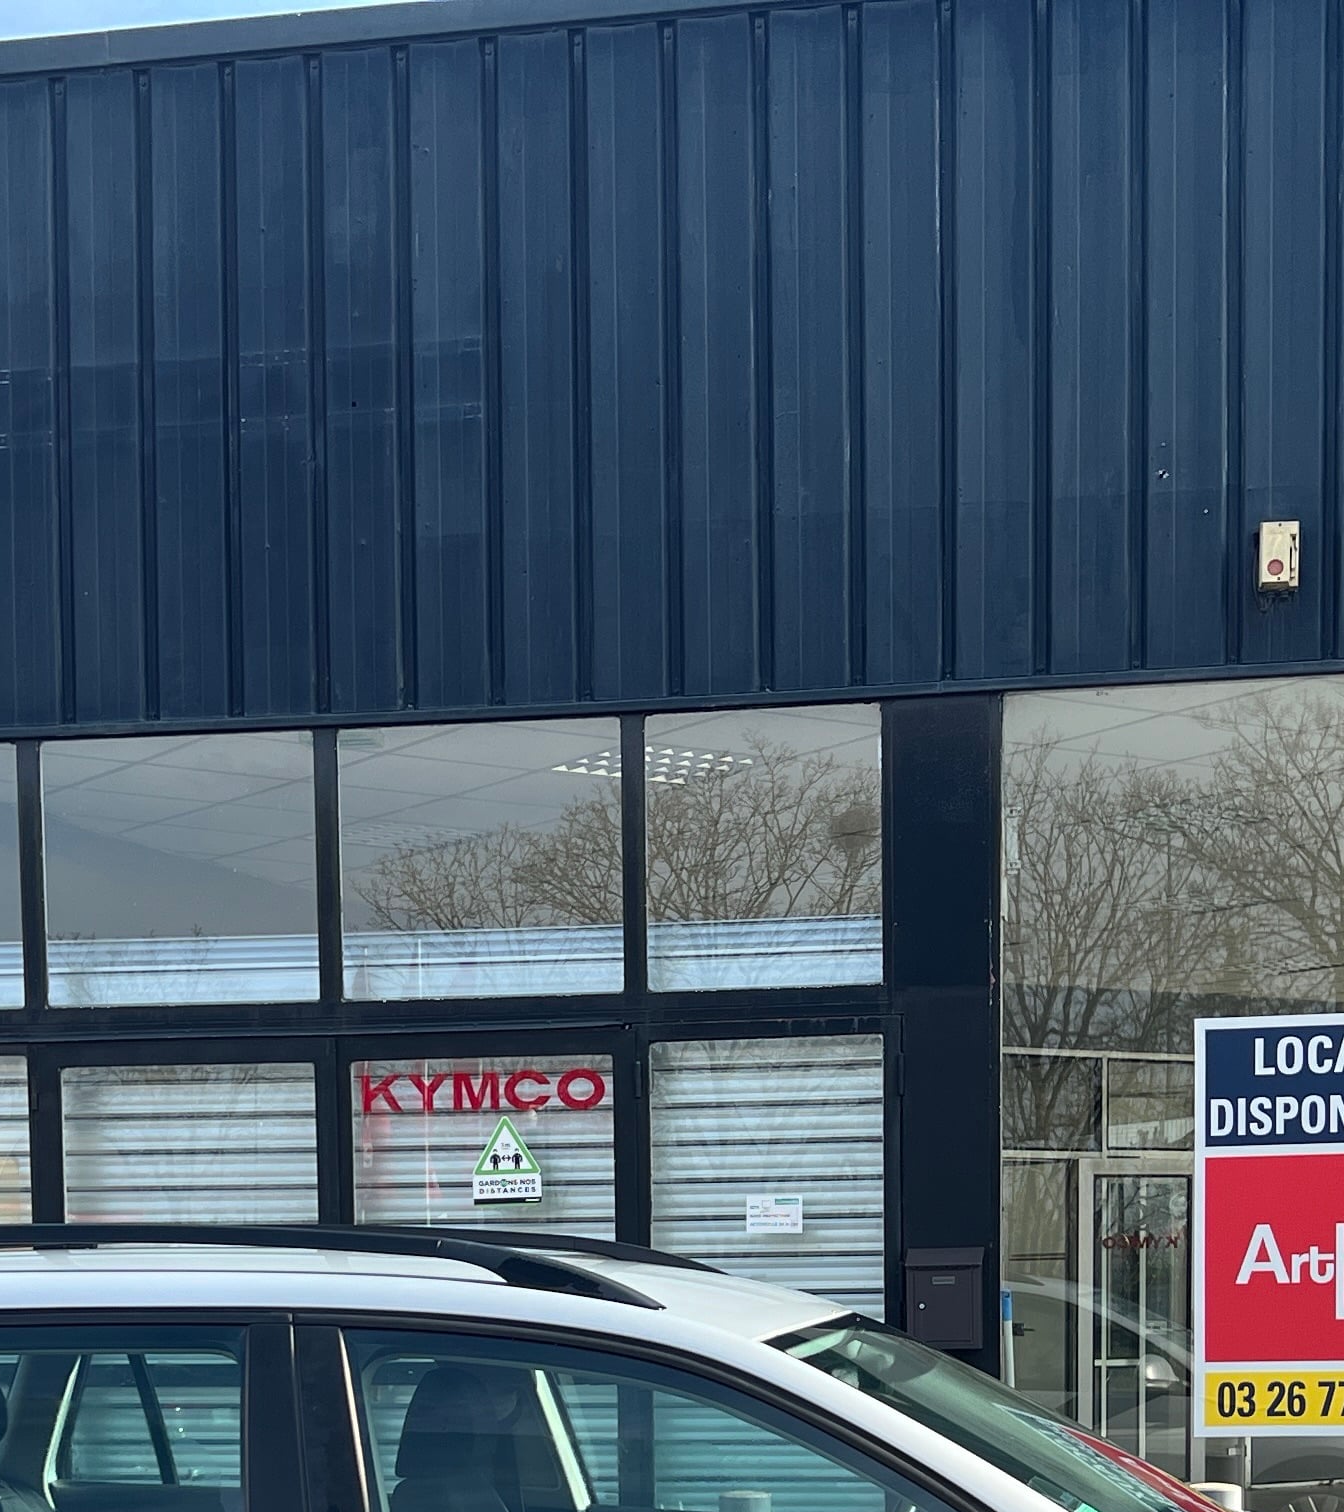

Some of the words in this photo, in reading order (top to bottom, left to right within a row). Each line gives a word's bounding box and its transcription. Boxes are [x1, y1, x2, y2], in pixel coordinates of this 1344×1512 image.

[361, 1068, 607, 1114] KYMCO
[478, 1186, 537, 1195] DISTANCES
[520, 1178, 537, 1186] NOS
[1217, 1381, 1256, 1418] 03
[1266, 1381, 1306, 1417] 26
